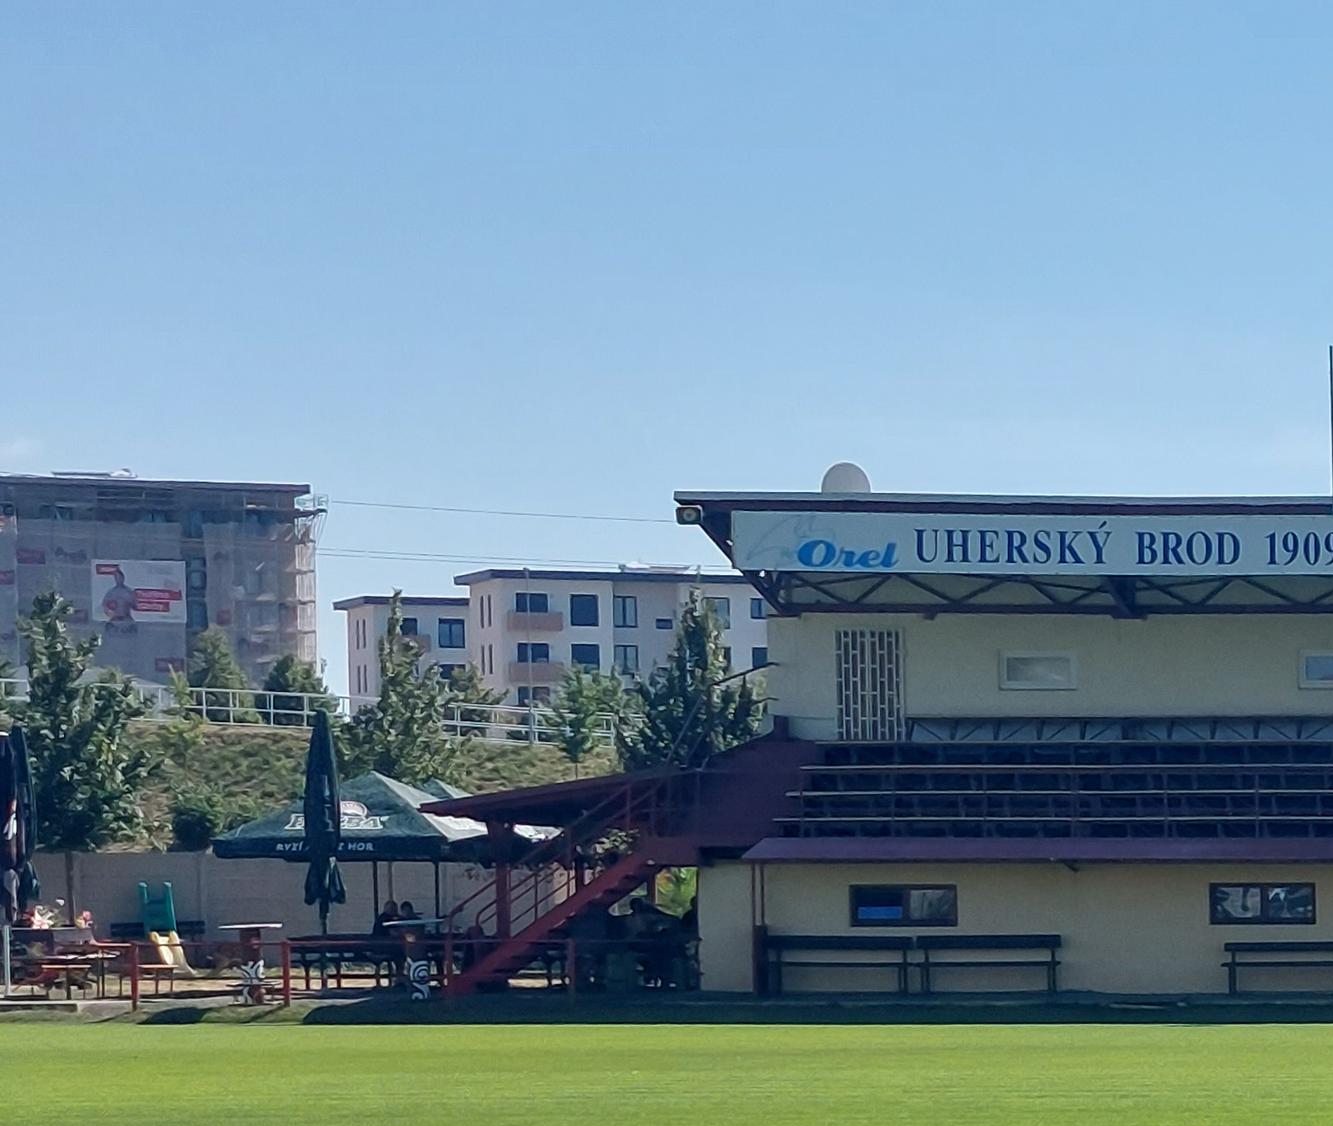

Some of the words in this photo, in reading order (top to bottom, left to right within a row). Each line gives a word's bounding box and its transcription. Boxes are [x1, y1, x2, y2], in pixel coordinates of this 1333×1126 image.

[797, 539, 900, 568] Orel
[914, 520, 1112, 565] UHERSKÝ
[1135, 531, 1241, 565] BROD
